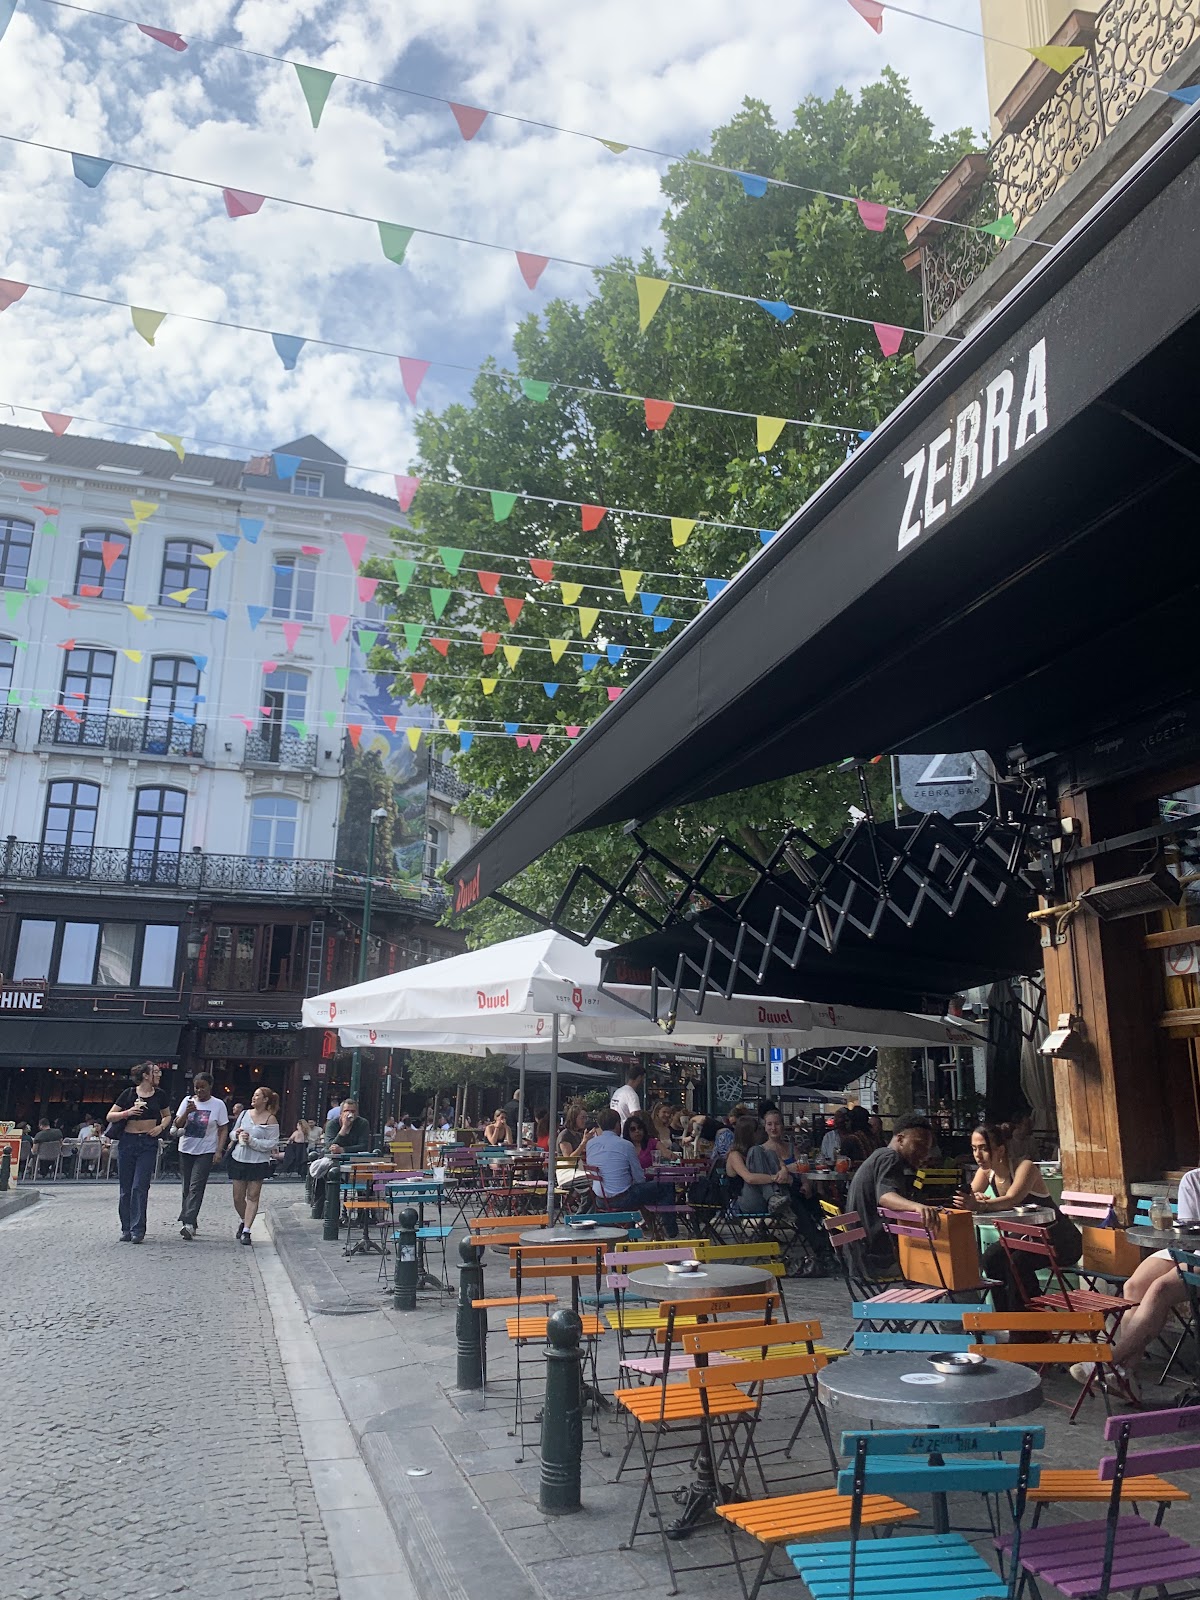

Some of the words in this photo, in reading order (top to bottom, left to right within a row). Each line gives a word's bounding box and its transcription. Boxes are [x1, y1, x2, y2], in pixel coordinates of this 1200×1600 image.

[897, 336, 1048, 552] ZEBRA
[914, 789, 950, 798] ZEBRA
[958, 787, 980, 795] BAR
[455, 862, 481, 913] Duvel
[0, 991, 45, 1010] HINE
[476, 989, 510, 1009] Duvel
[758, 1006, 793, 1024] Duvel
